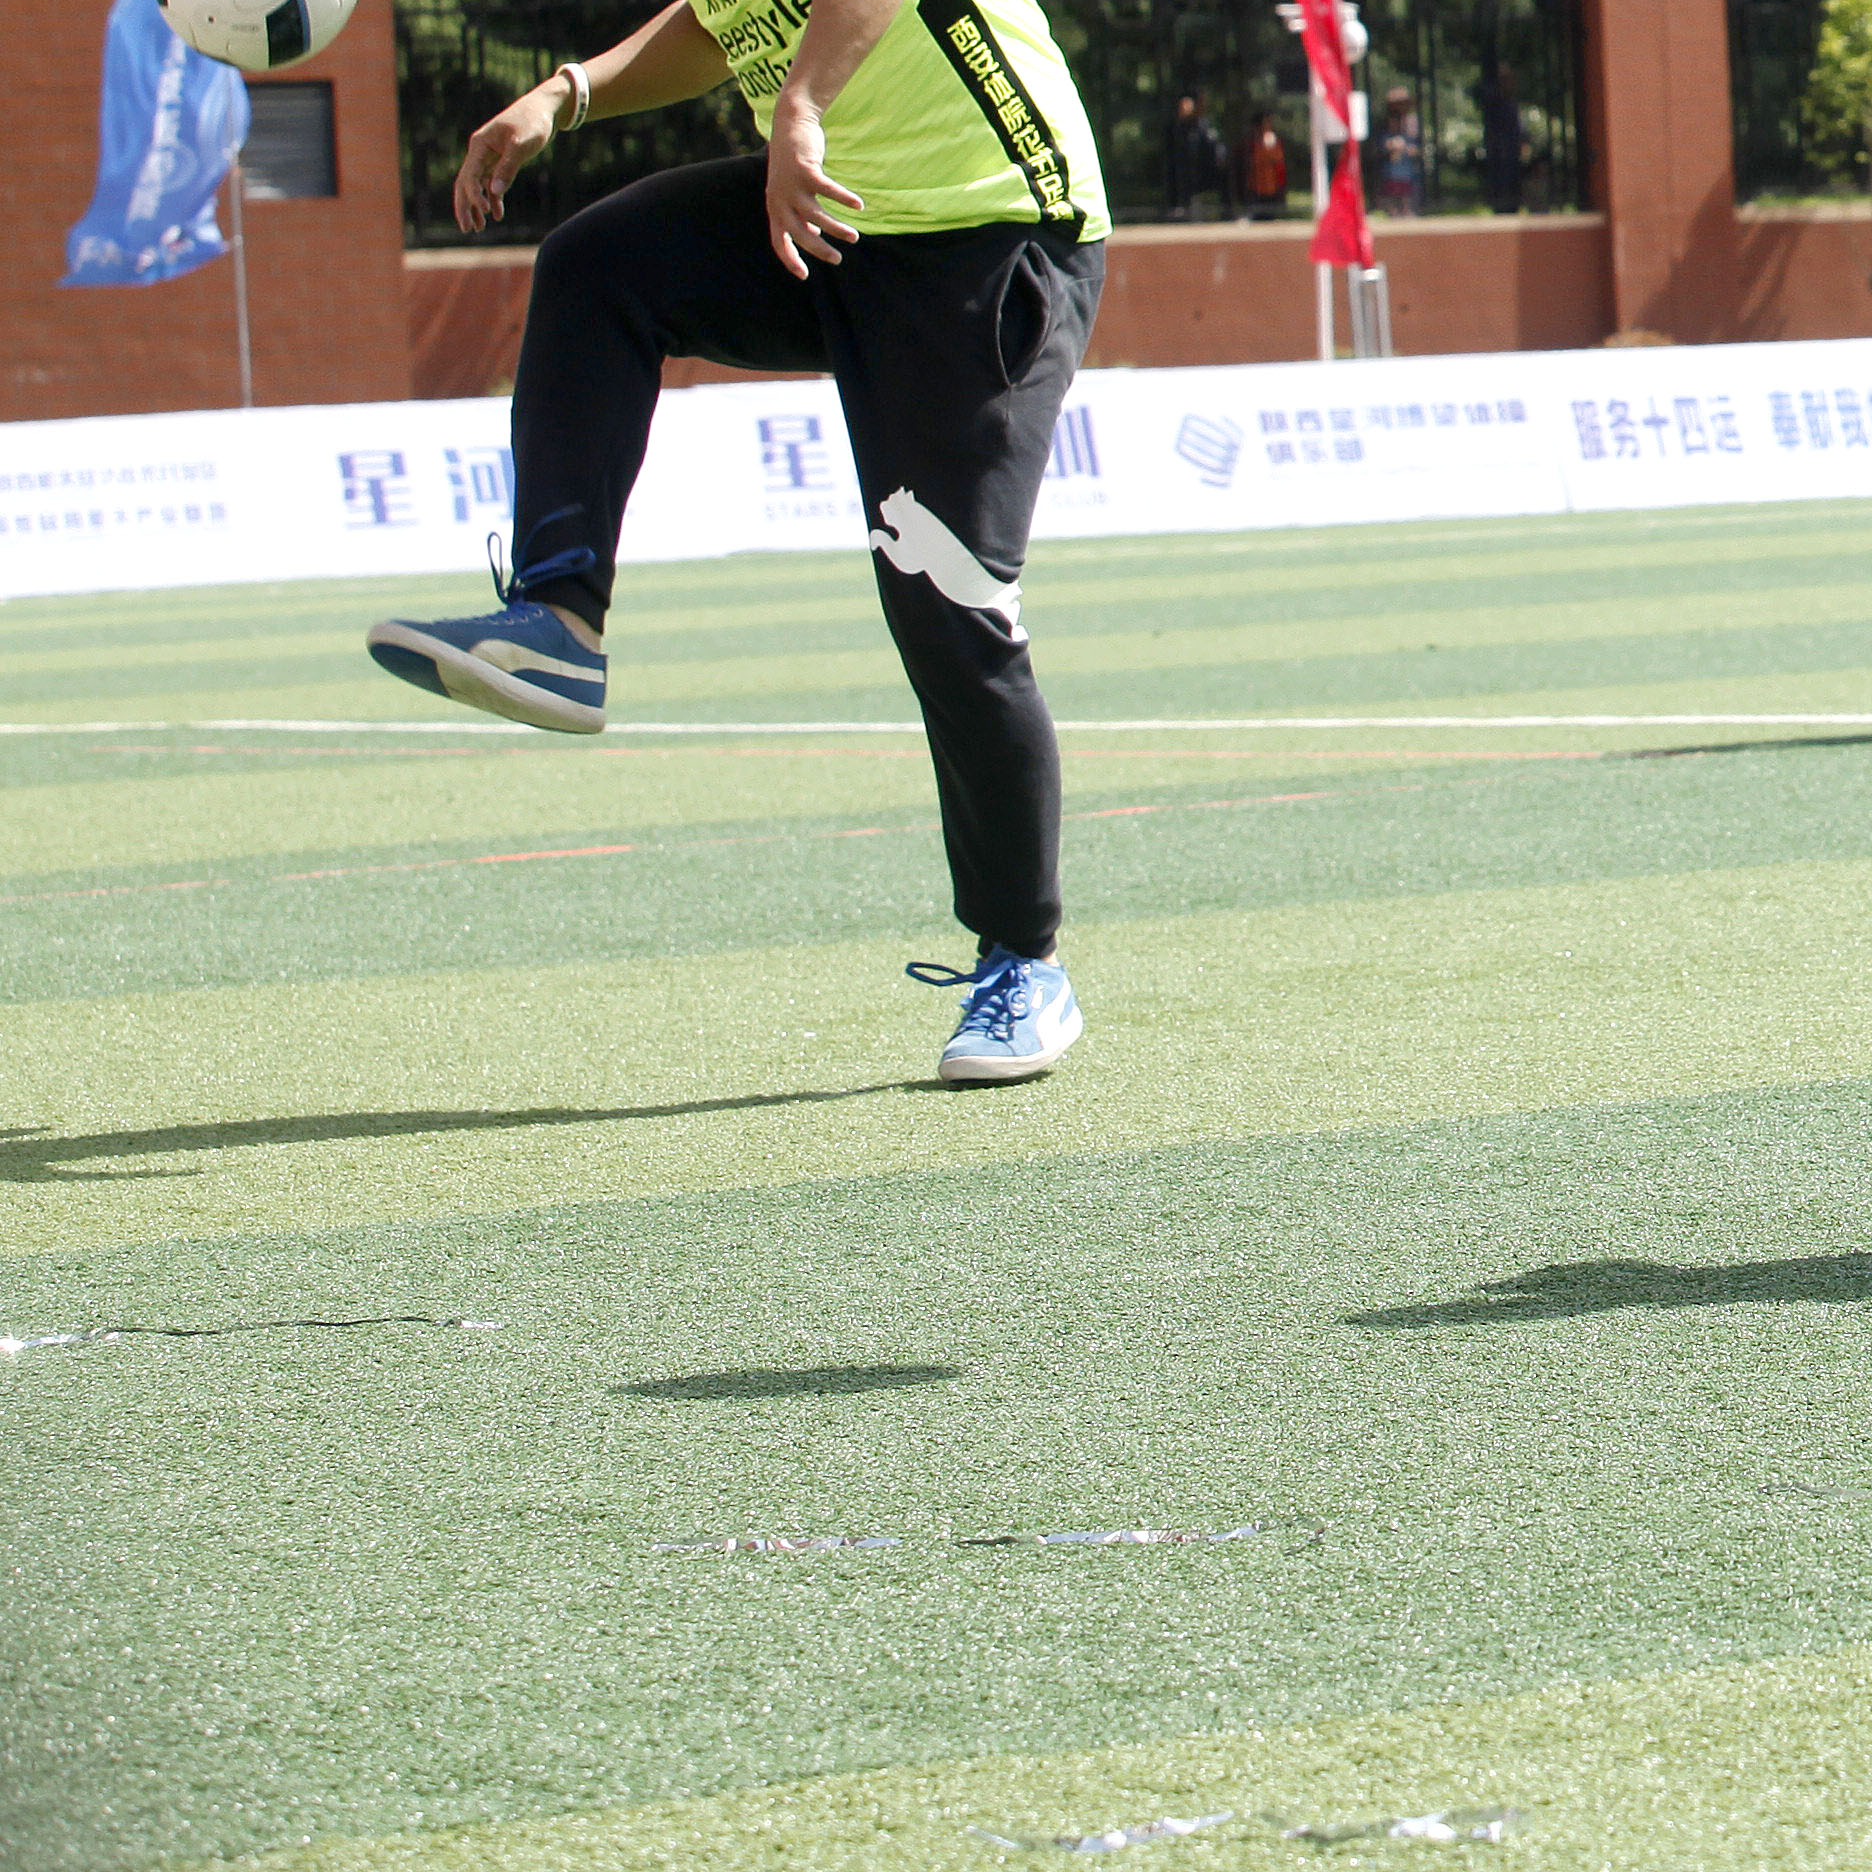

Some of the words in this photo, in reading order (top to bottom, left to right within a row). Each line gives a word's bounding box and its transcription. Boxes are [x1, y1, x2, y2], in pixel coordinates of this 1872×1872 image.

[1571, 394, 1744, 461] 服务十四运
